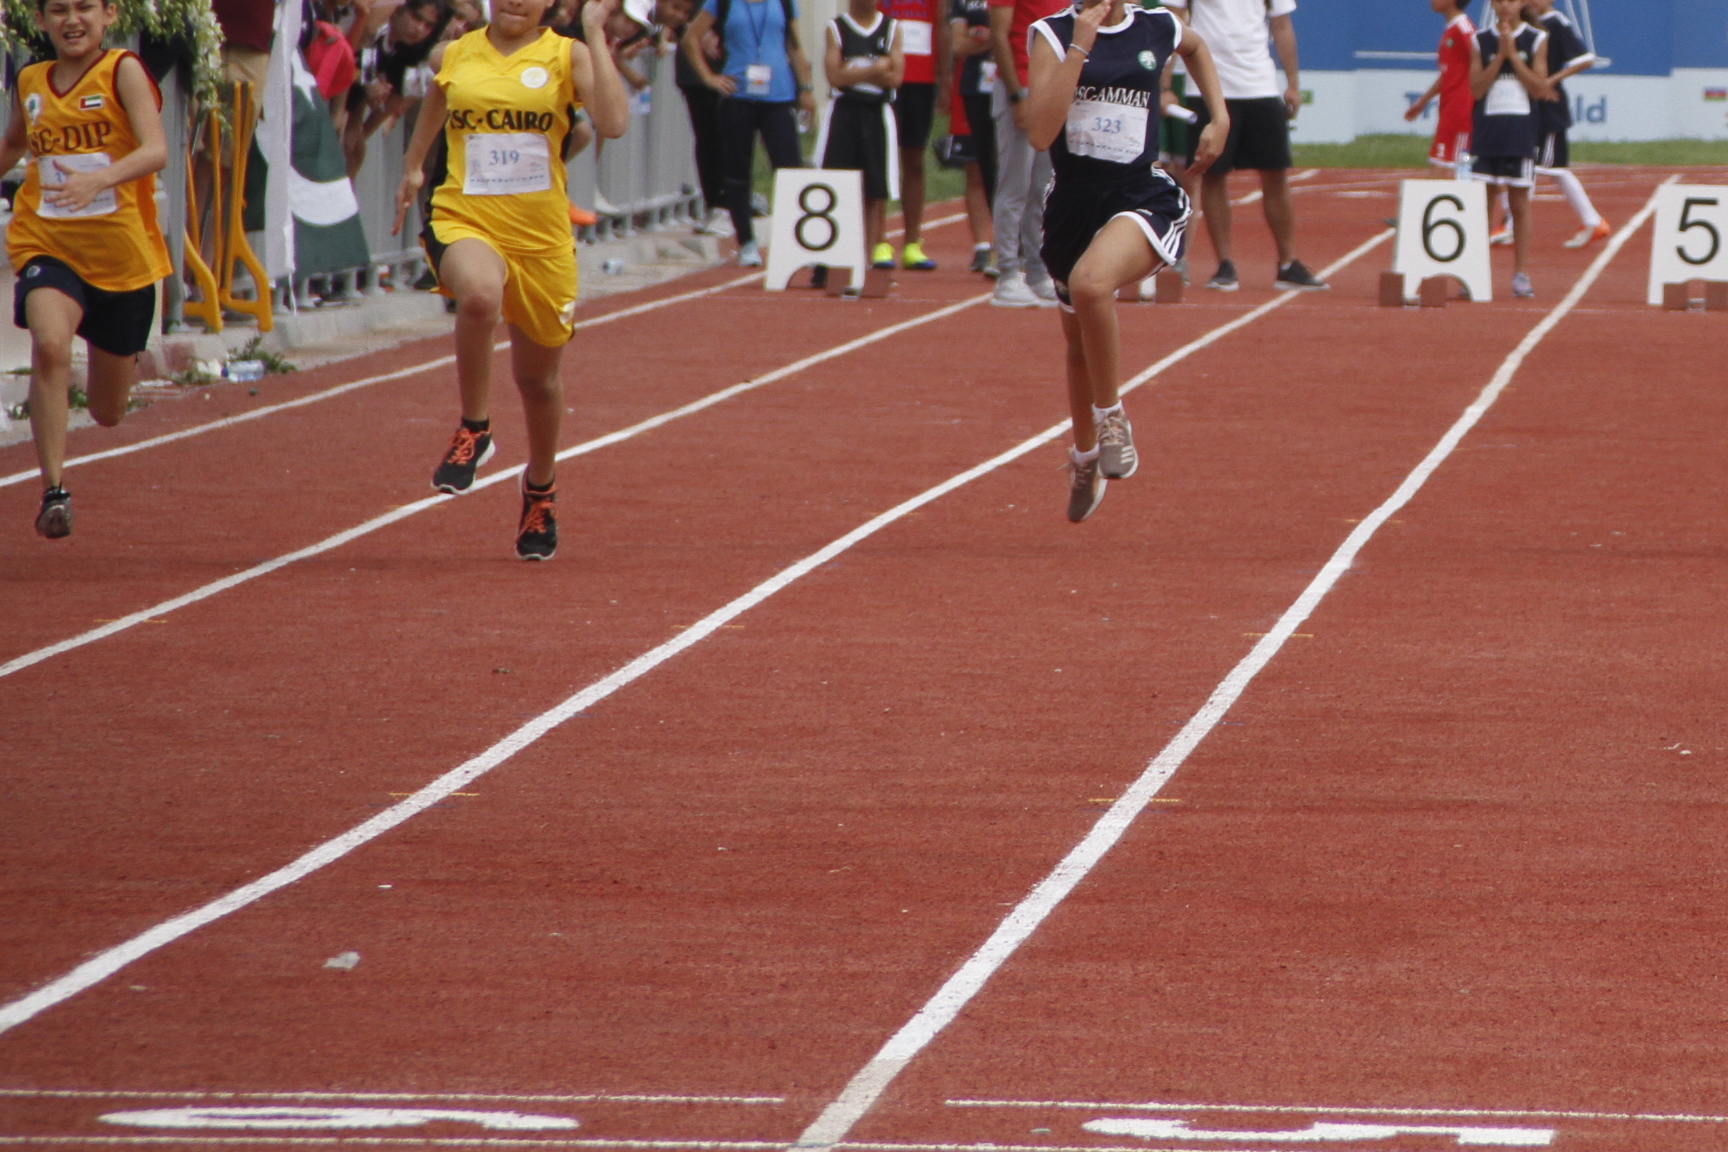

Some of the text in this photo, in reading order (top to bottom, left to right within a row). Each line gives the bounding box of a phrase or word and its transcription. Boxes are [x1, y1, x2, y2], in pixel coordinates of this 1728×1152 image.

[1076, 86, 1151, 108] SC-AMMAN
[450, 109, 554, 132] SC-CAIRO
[1092, 116, 1122, 134] 323
[30, 121, 111, 157] SC-DIP
[489, 149, 520, 166] 319
[794, 182, 838, 252] 8
[1422, 193, 1465, 262] 6
[1676, 197, 1720, 265] 5
